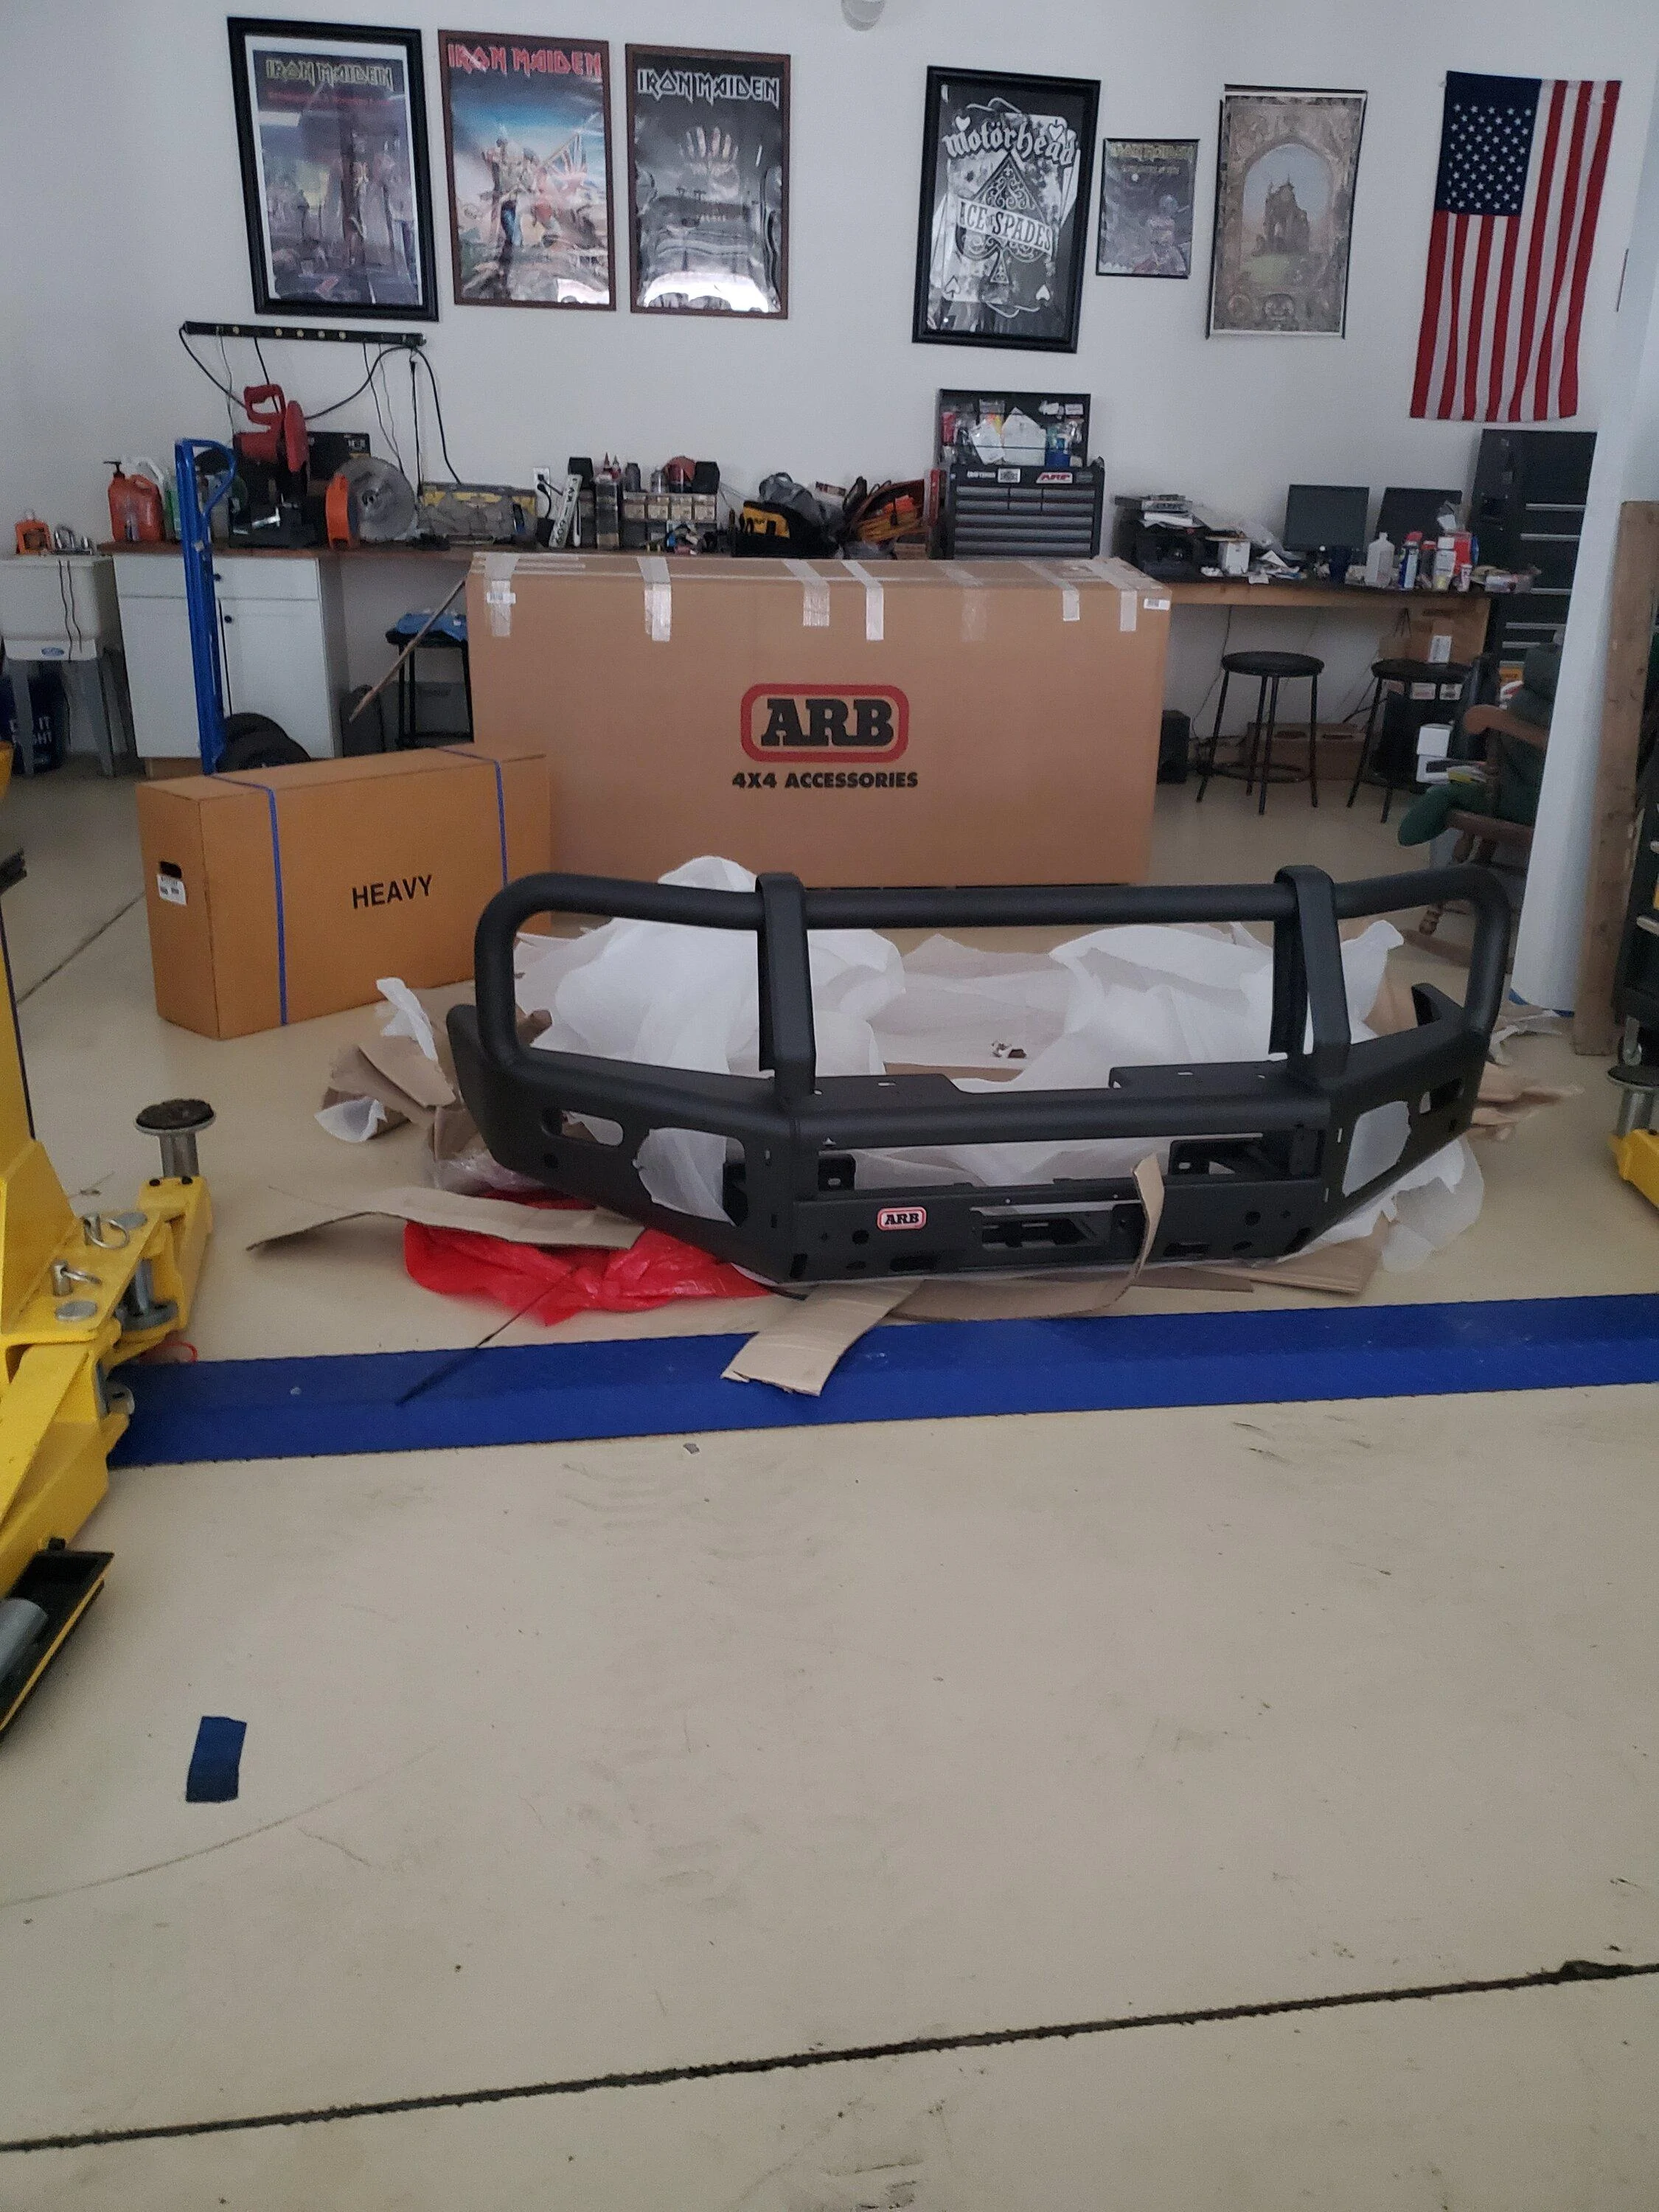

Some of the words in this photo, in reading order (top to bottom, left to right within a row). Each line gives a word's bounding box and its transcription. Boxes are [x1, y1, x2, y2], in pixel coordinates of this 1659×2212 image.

[266, 58, 315, 87] IRON
[316, 62, 395, 91] MAIDEN
[448, 44, 507, 76] IRON
[511, 47, 602, 82] MAIDEN
[637, 69, 693, 104] IRON
[694, 72, 781, 111] MAIDEN
[992, 211, 1051, 251] SPADES
[761, 698, 894, 747] ARB
[732, 772, 777, 789] 4X4
[784, 771, 919, 789] ACCESSORIES
[352, 874, 432, 909] HEAVY
[885, 1213, 919, 1225] ARB
